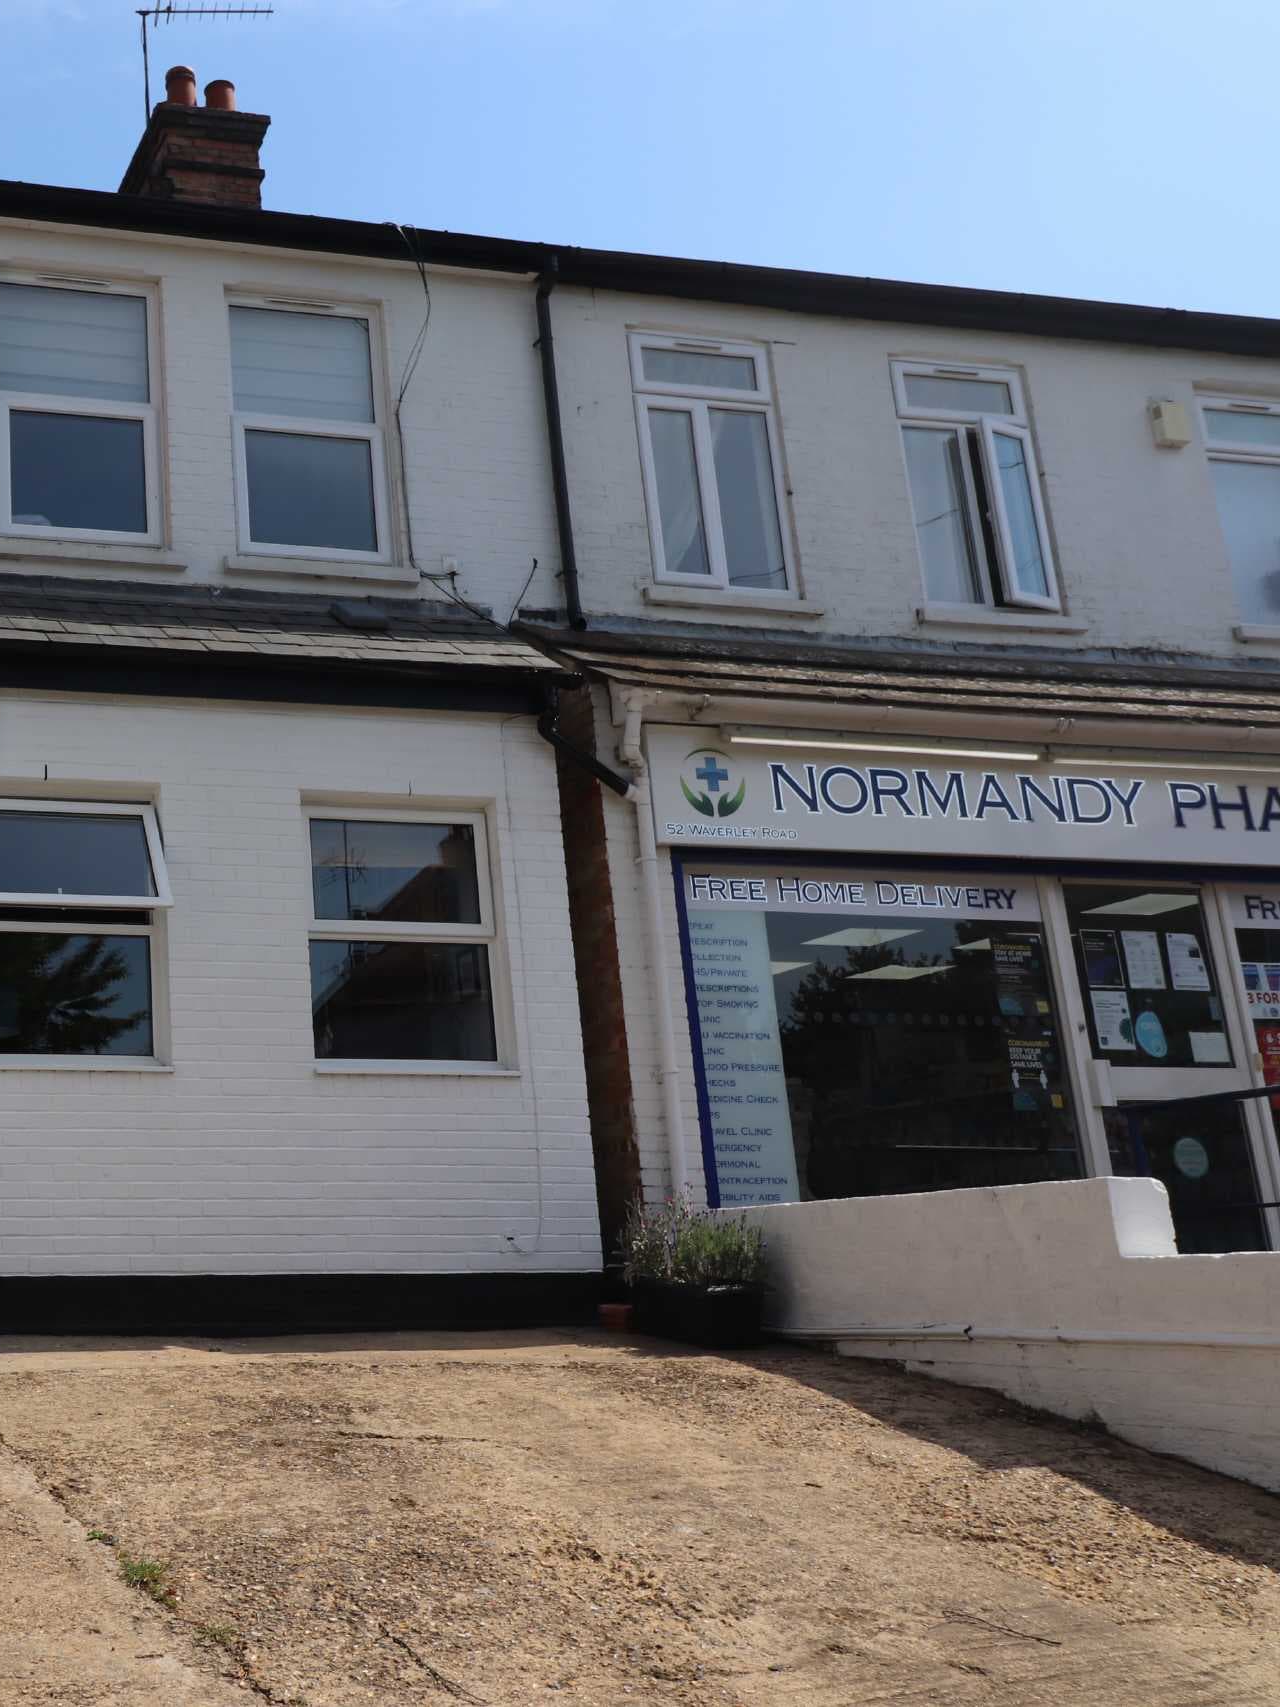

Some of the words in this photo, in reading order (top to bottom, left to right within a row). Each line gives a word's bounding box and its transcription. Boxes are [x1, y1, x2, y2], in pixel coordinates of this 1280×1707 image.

[768, 763, 1144, 827] NORMANDY
[665, 823, 684, 836] 52
[688, 824, 757, 838] WAVERLEY
[762, 827, 798, 840] ROAD
[688, 873, 767, 904] FREE
[775, 876, 867, 906] HOME
[872, 879, 1017, 911] DELIVERY
